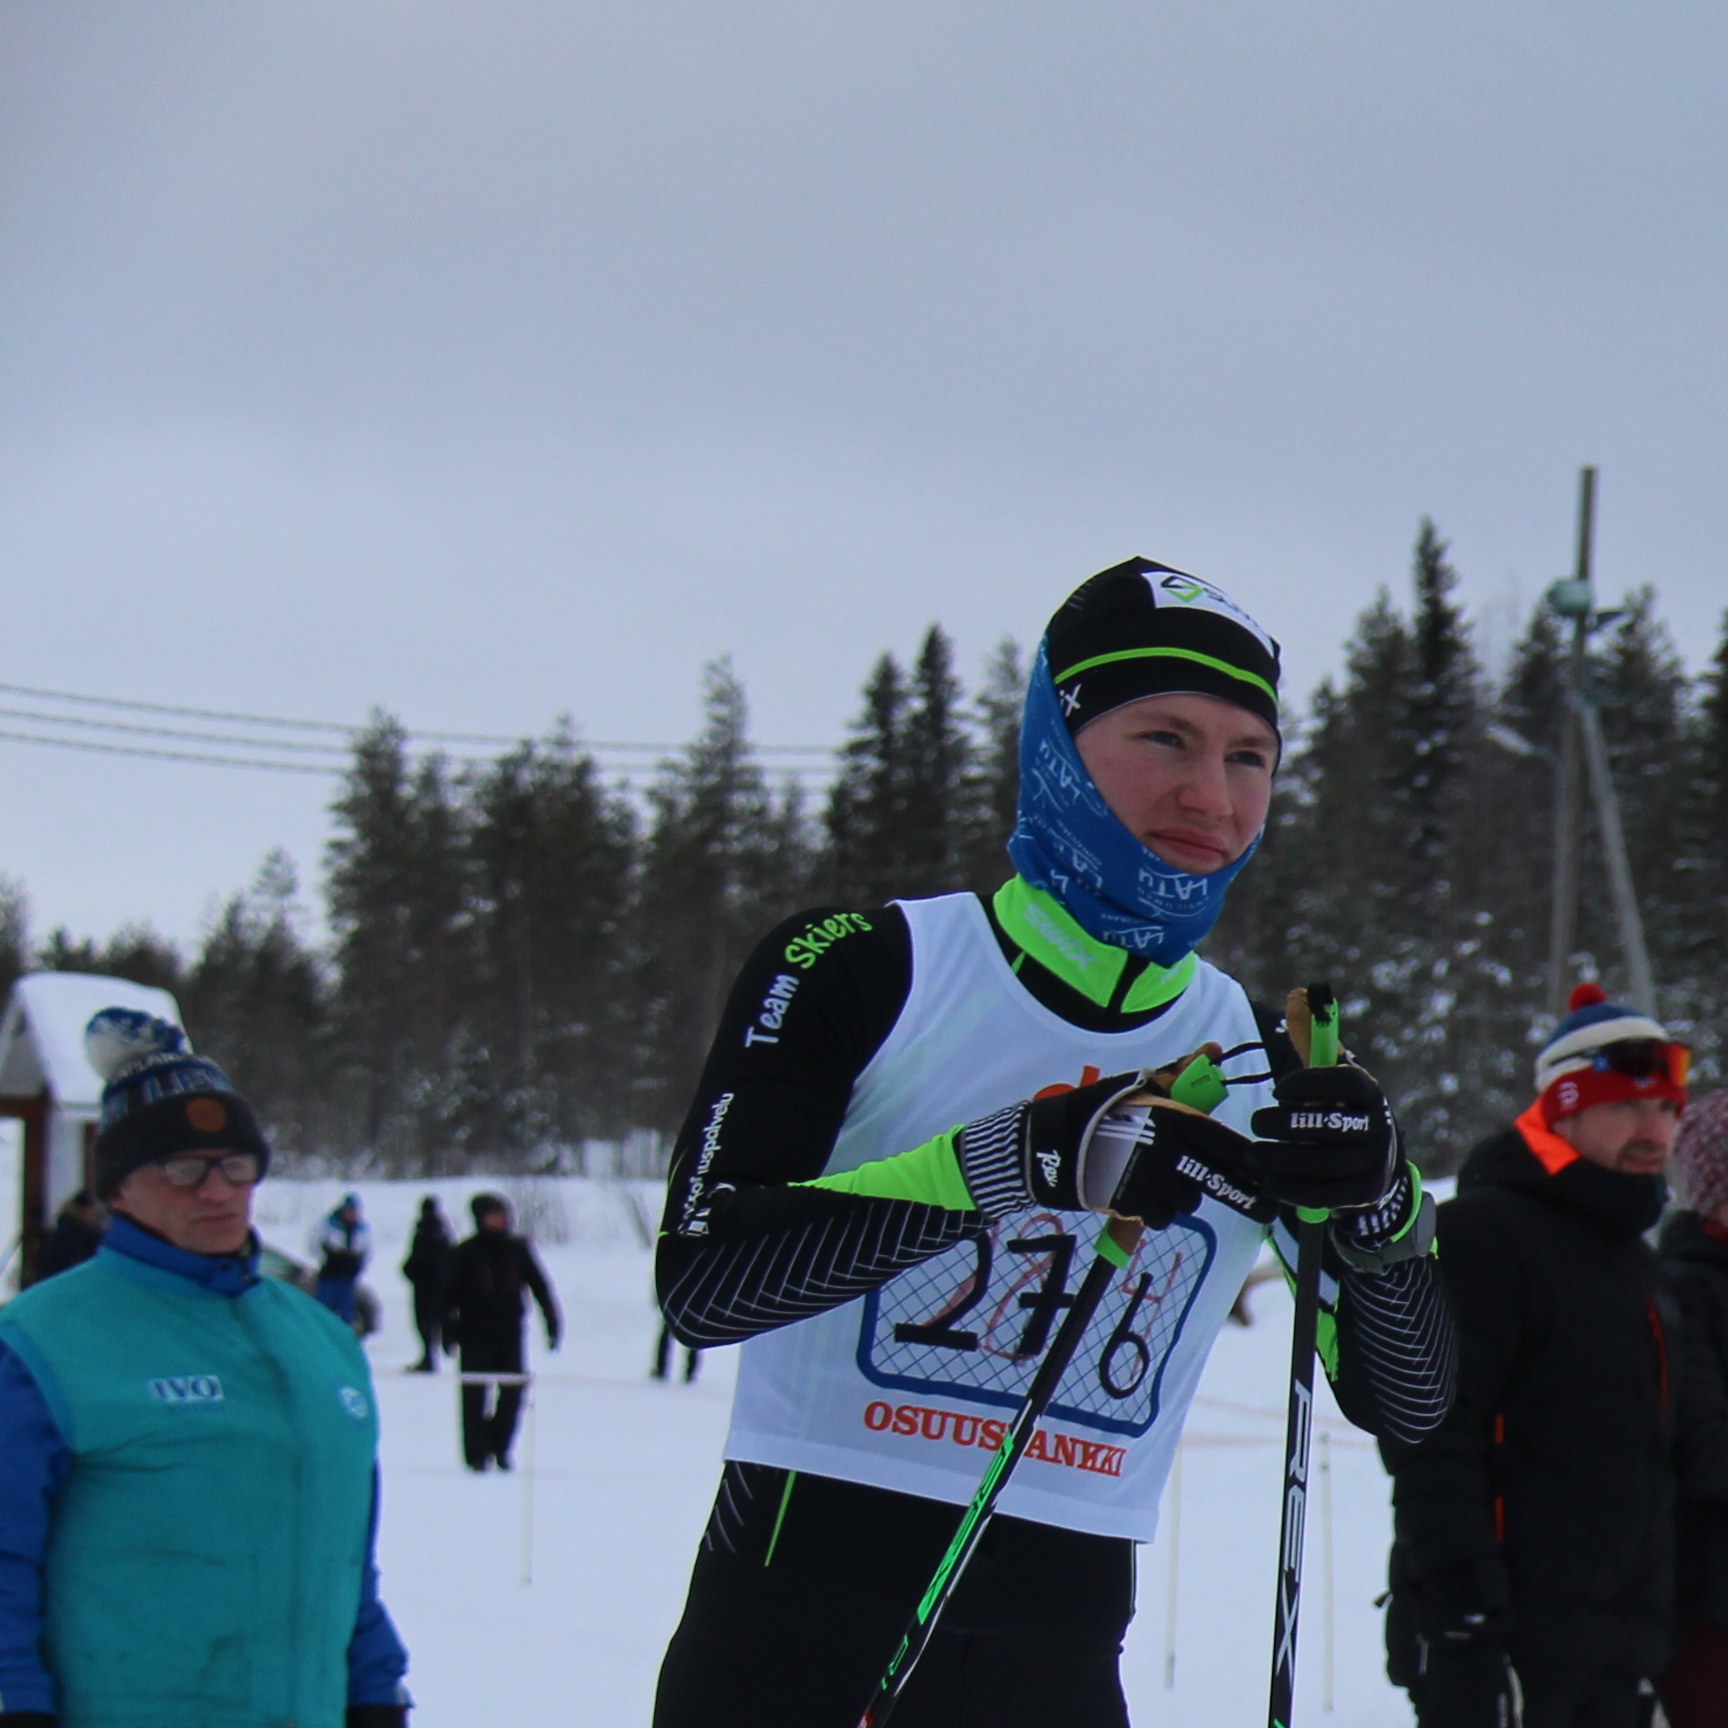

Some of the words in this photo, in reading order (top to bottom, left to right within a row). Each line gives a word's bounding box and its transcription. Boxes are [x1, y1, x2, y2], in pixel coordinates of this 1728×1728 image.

[744, 973, 801, 1048] Team
[784, 911, 873, 970] Skiers
[863, 1400, 1127, 1478] OSUUSANKKI
